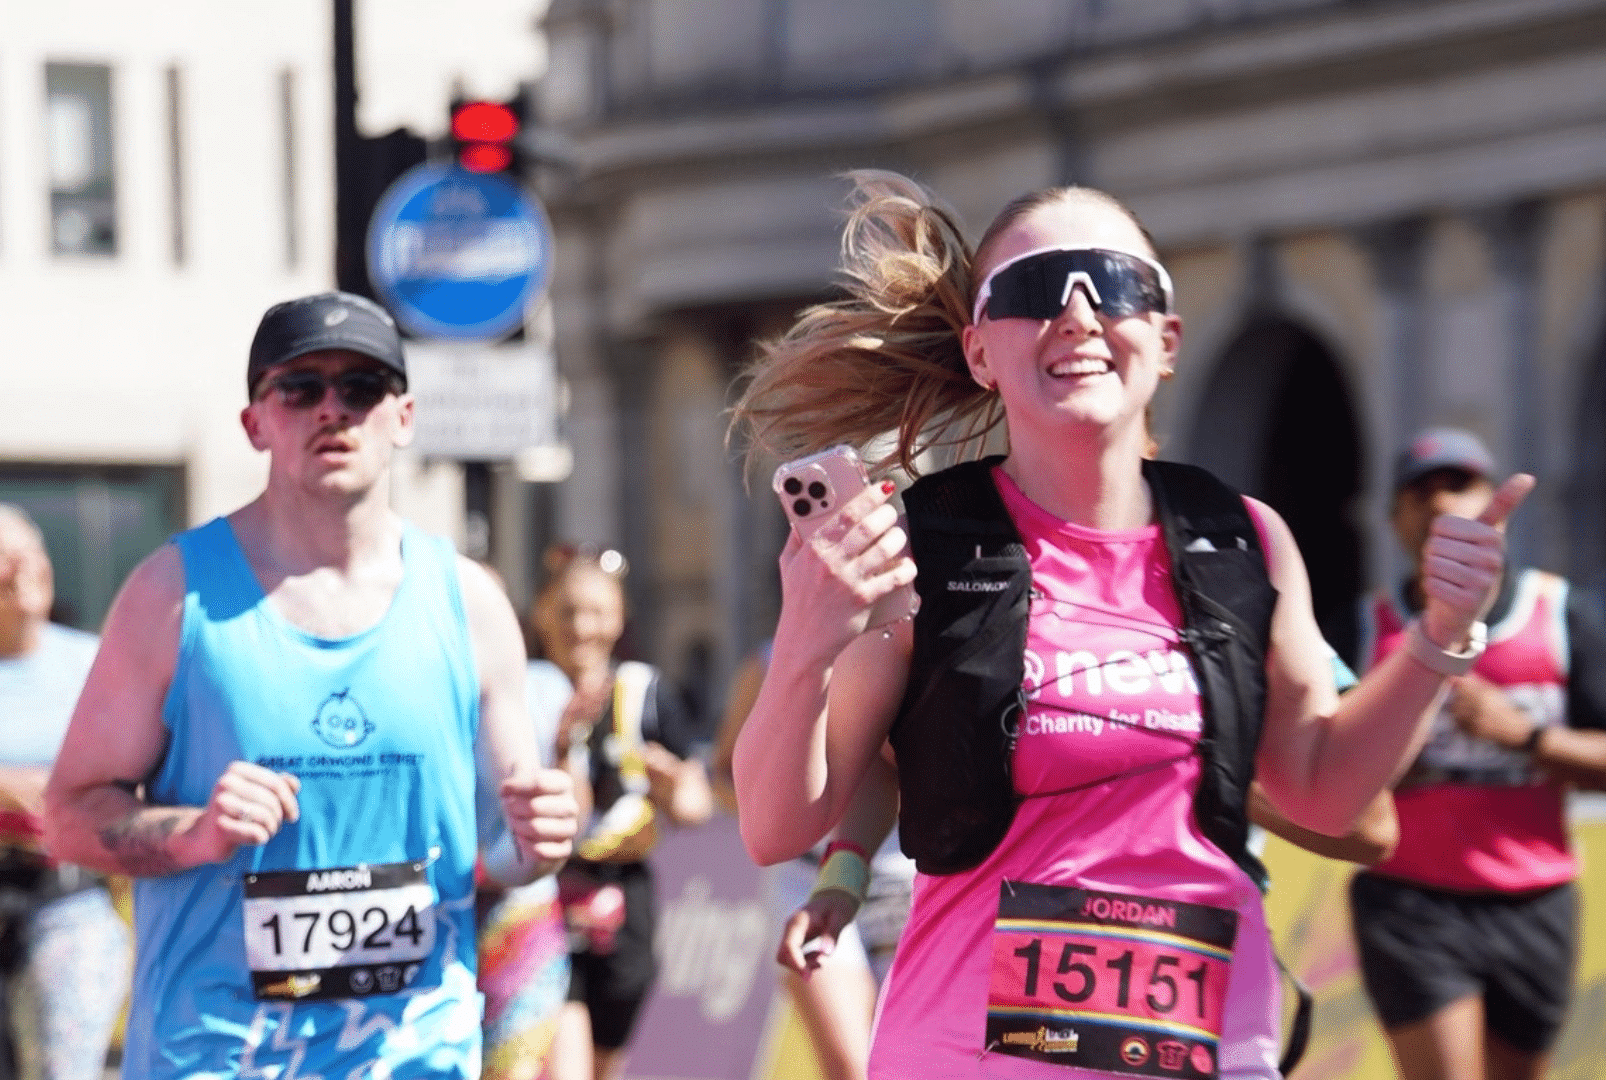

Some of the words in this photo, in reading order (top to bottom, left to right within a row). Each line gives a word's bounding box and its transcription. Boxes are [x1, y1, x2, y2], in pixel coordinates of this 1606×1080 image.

[947, 580, 1011, 592] SALOMON
[1026, 712, 1104, 736] Charity
[1109, 707, 1140, 730] for
[306, 869, 372, 893] AARON
[1082, 897, 1176, 927] JORDAN
[261, 904, 424, 955] 17924
[1013, 938, 1208, 1019] 15151
